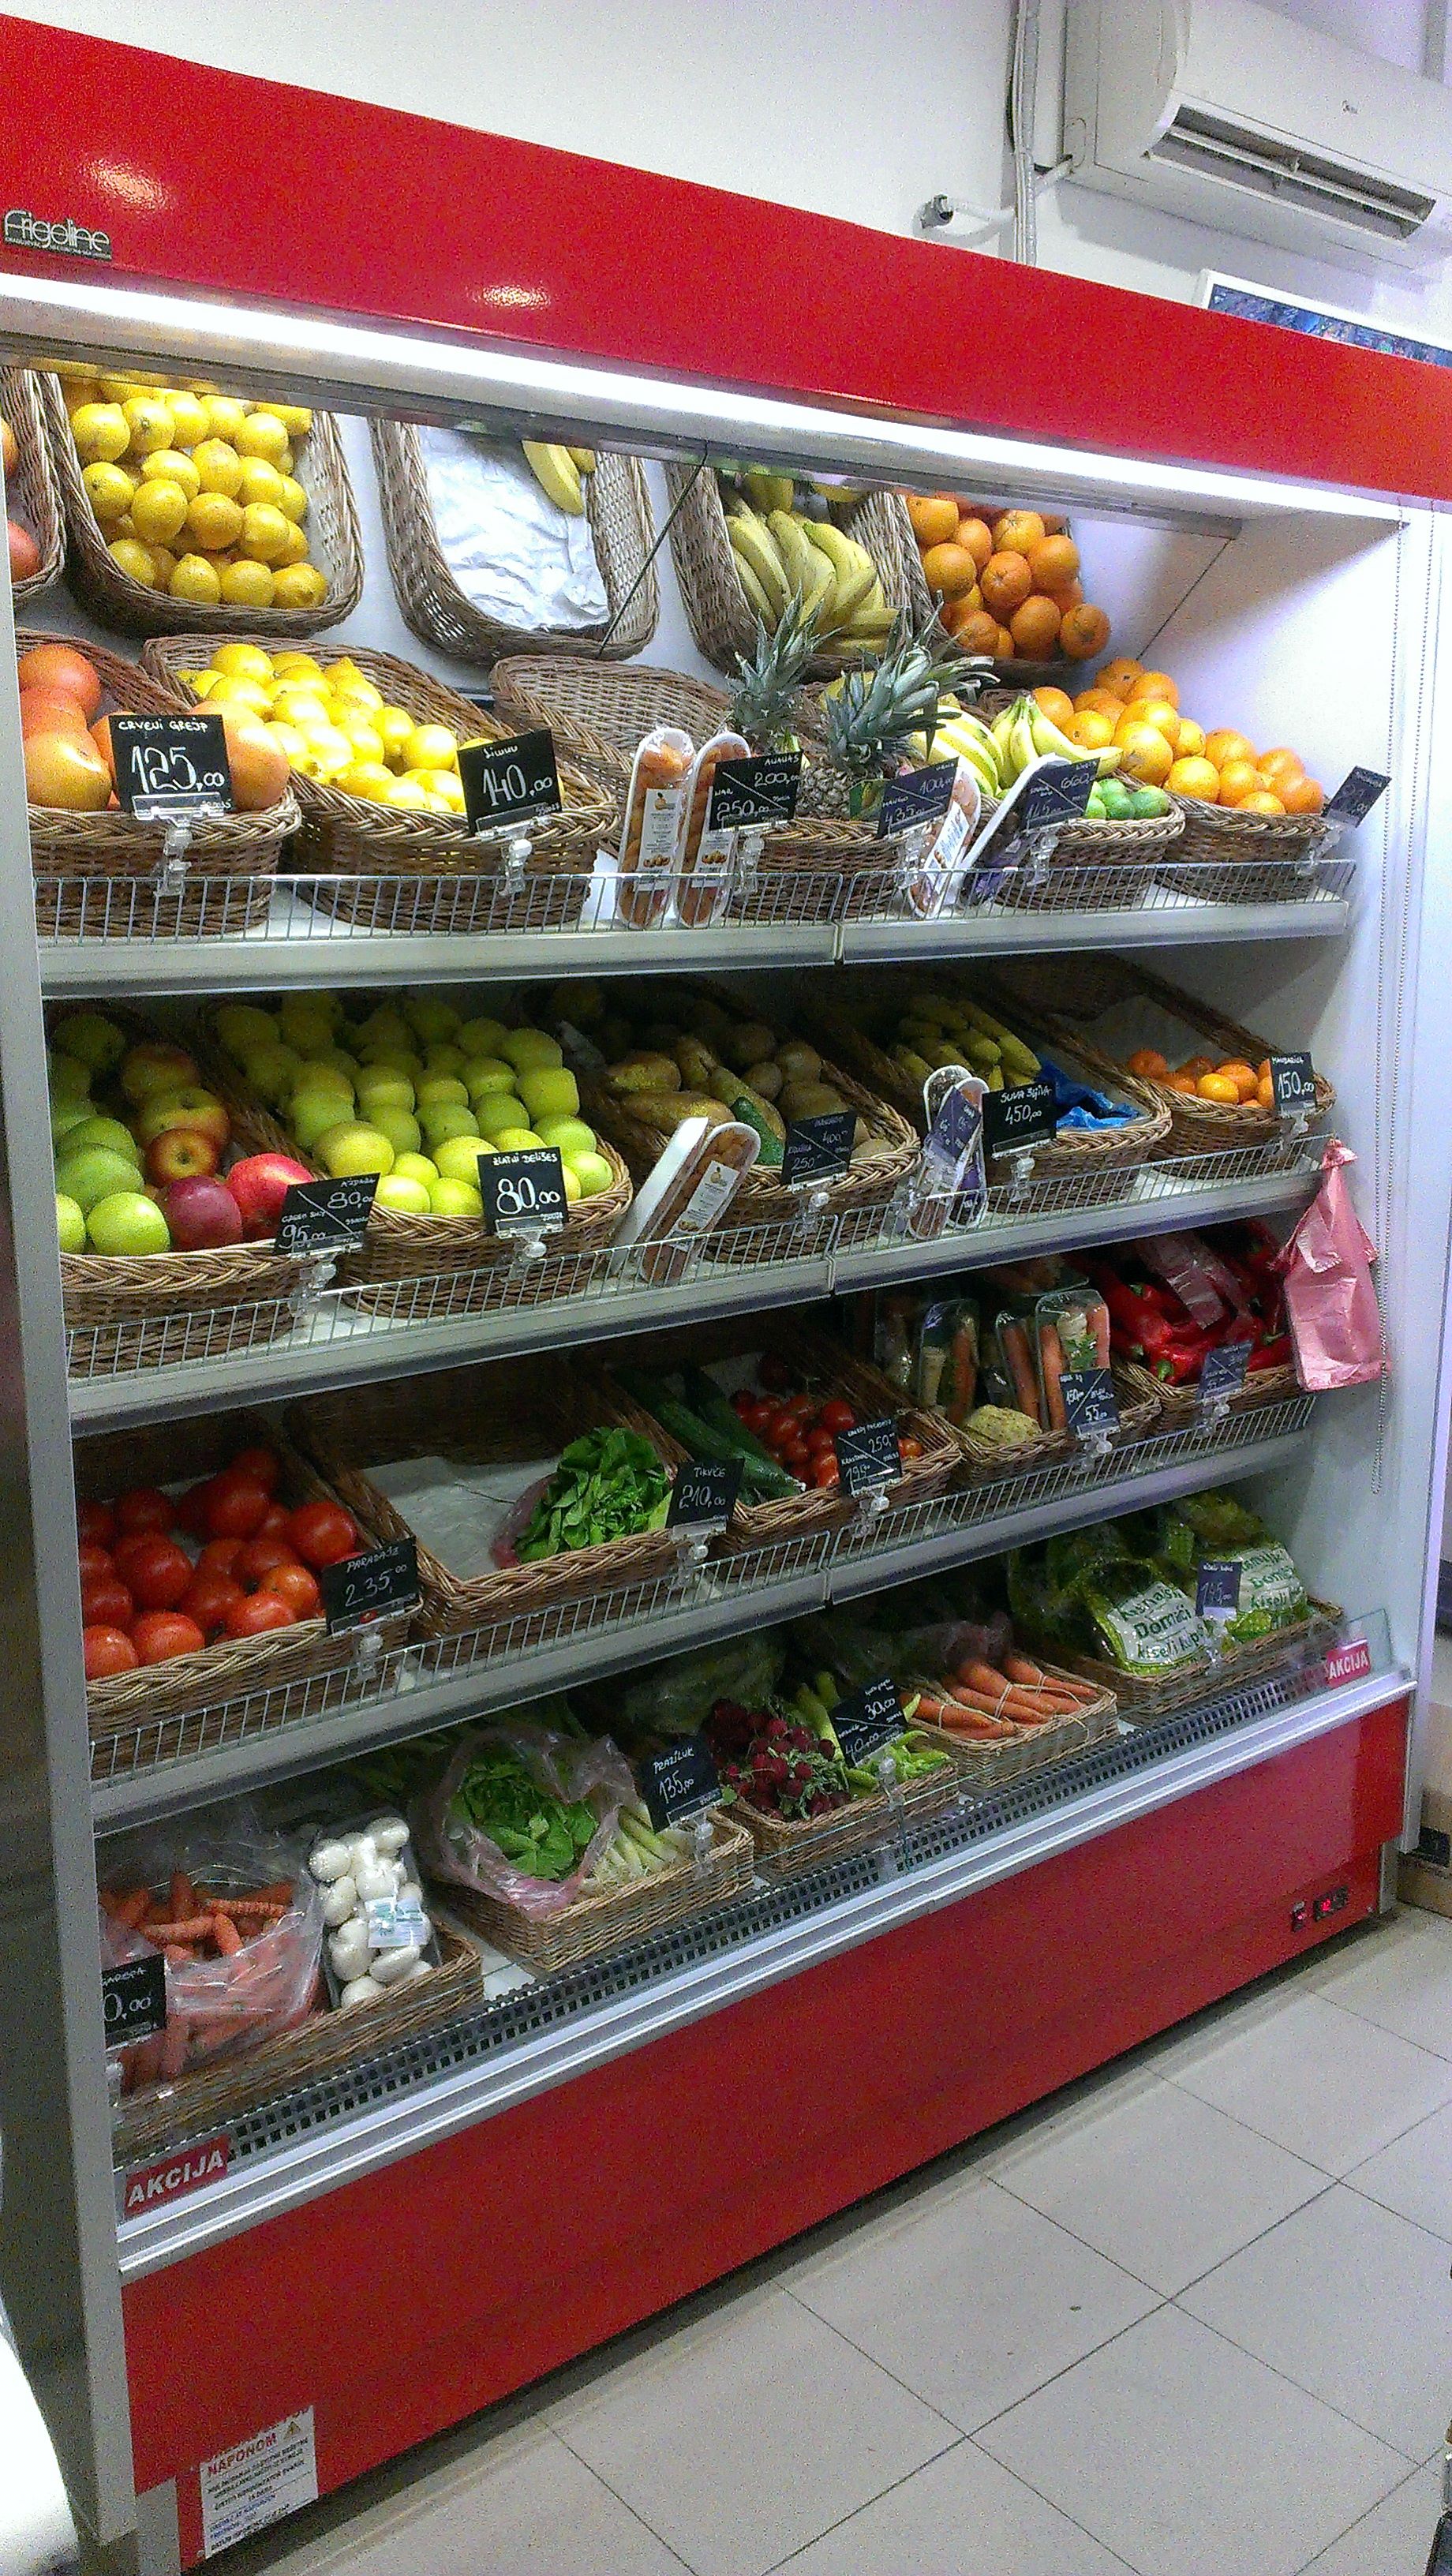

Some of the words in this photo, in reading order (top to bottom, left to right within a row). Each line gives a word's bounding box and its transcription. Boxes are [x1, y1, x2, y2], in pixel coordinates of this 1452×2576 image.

[132, 746, 225, 793] 125,00
[1005, 1105, 1042, 1125] 450,00
[679, 1485, 726, 1510] 210,00
[1329, 1649, 1369, 1680] AKCIJA
[864, 1698, 895, 1720] 30,00
[659, 1769, 694, 1804] 135,00
[128, 2149, 223, 2207] AKCIJA
